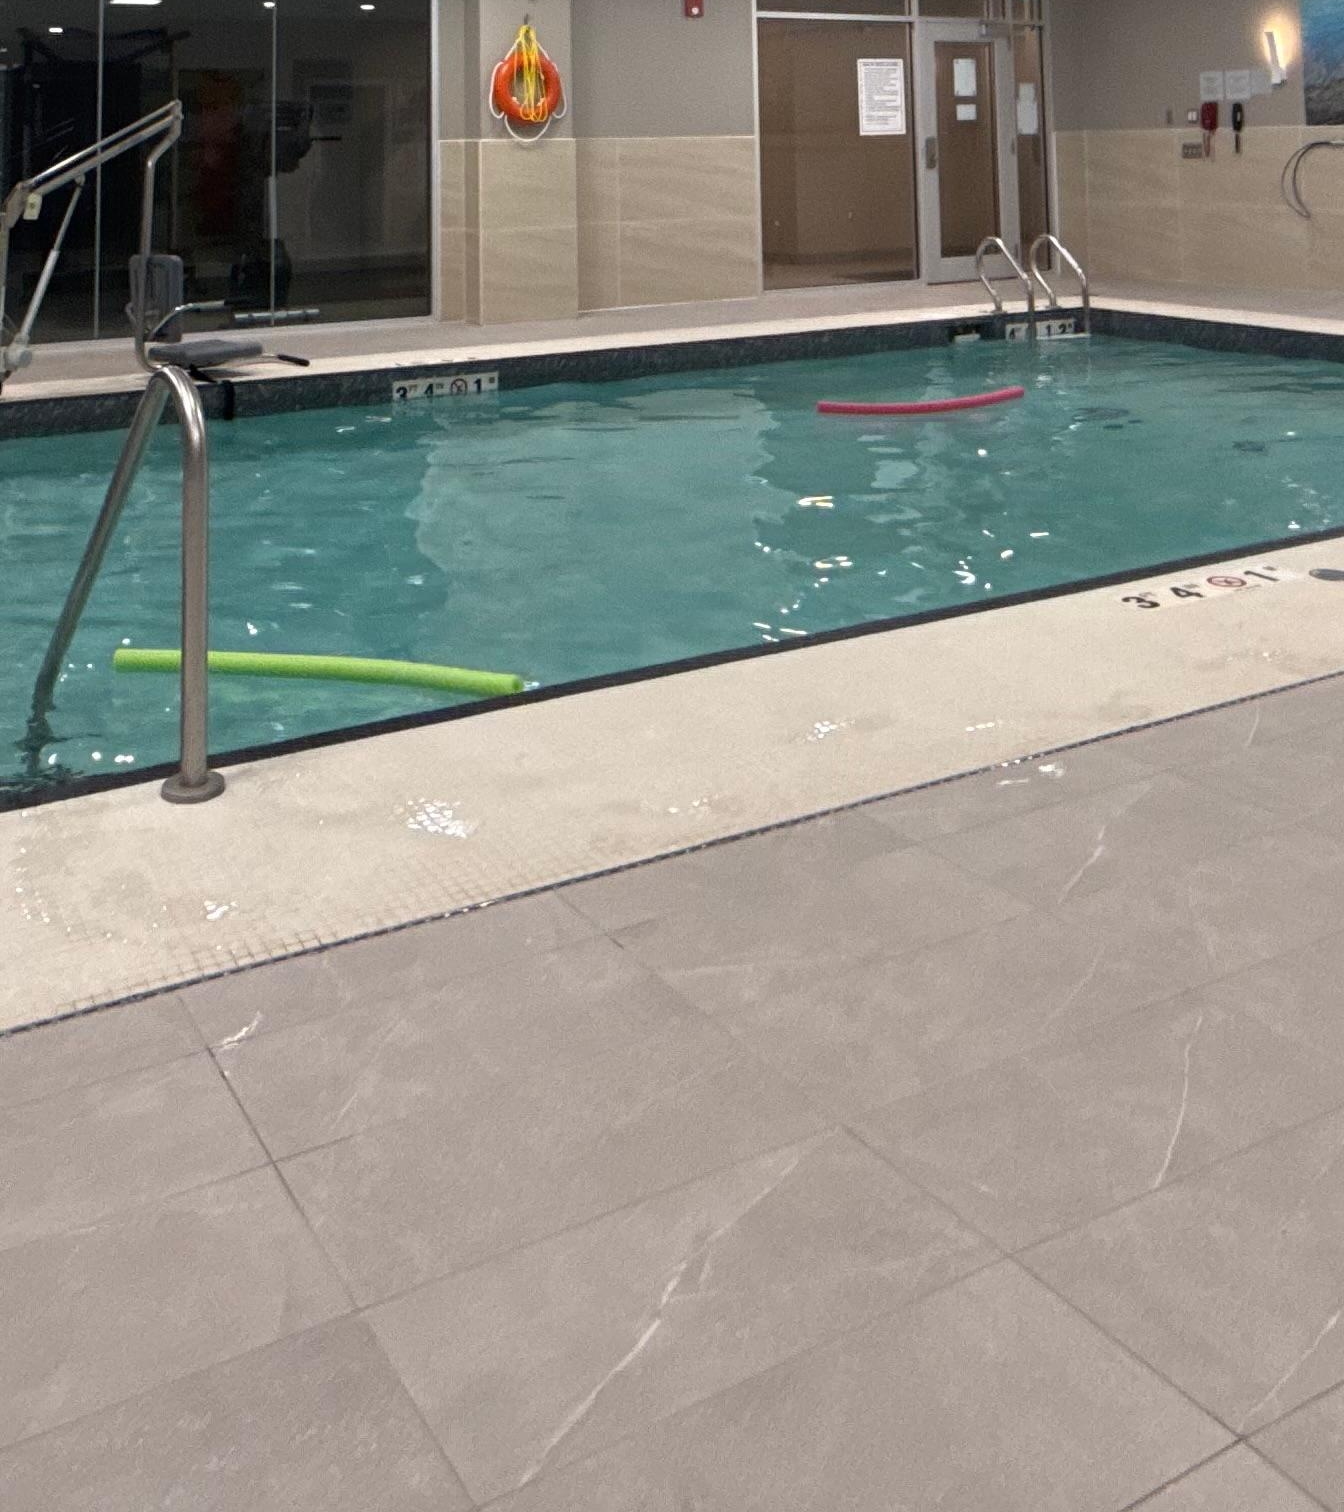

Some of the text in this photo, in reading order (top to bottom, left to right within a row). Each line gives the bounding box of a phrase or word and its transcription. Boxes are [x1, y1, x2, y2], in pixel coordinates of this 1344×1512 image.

[474, 378, 482, 393] 1
[1121, 596, 1161, 609] 3
[1170, 586, 1204, 598] 4
[1243, 570, 1280, 583] 1
